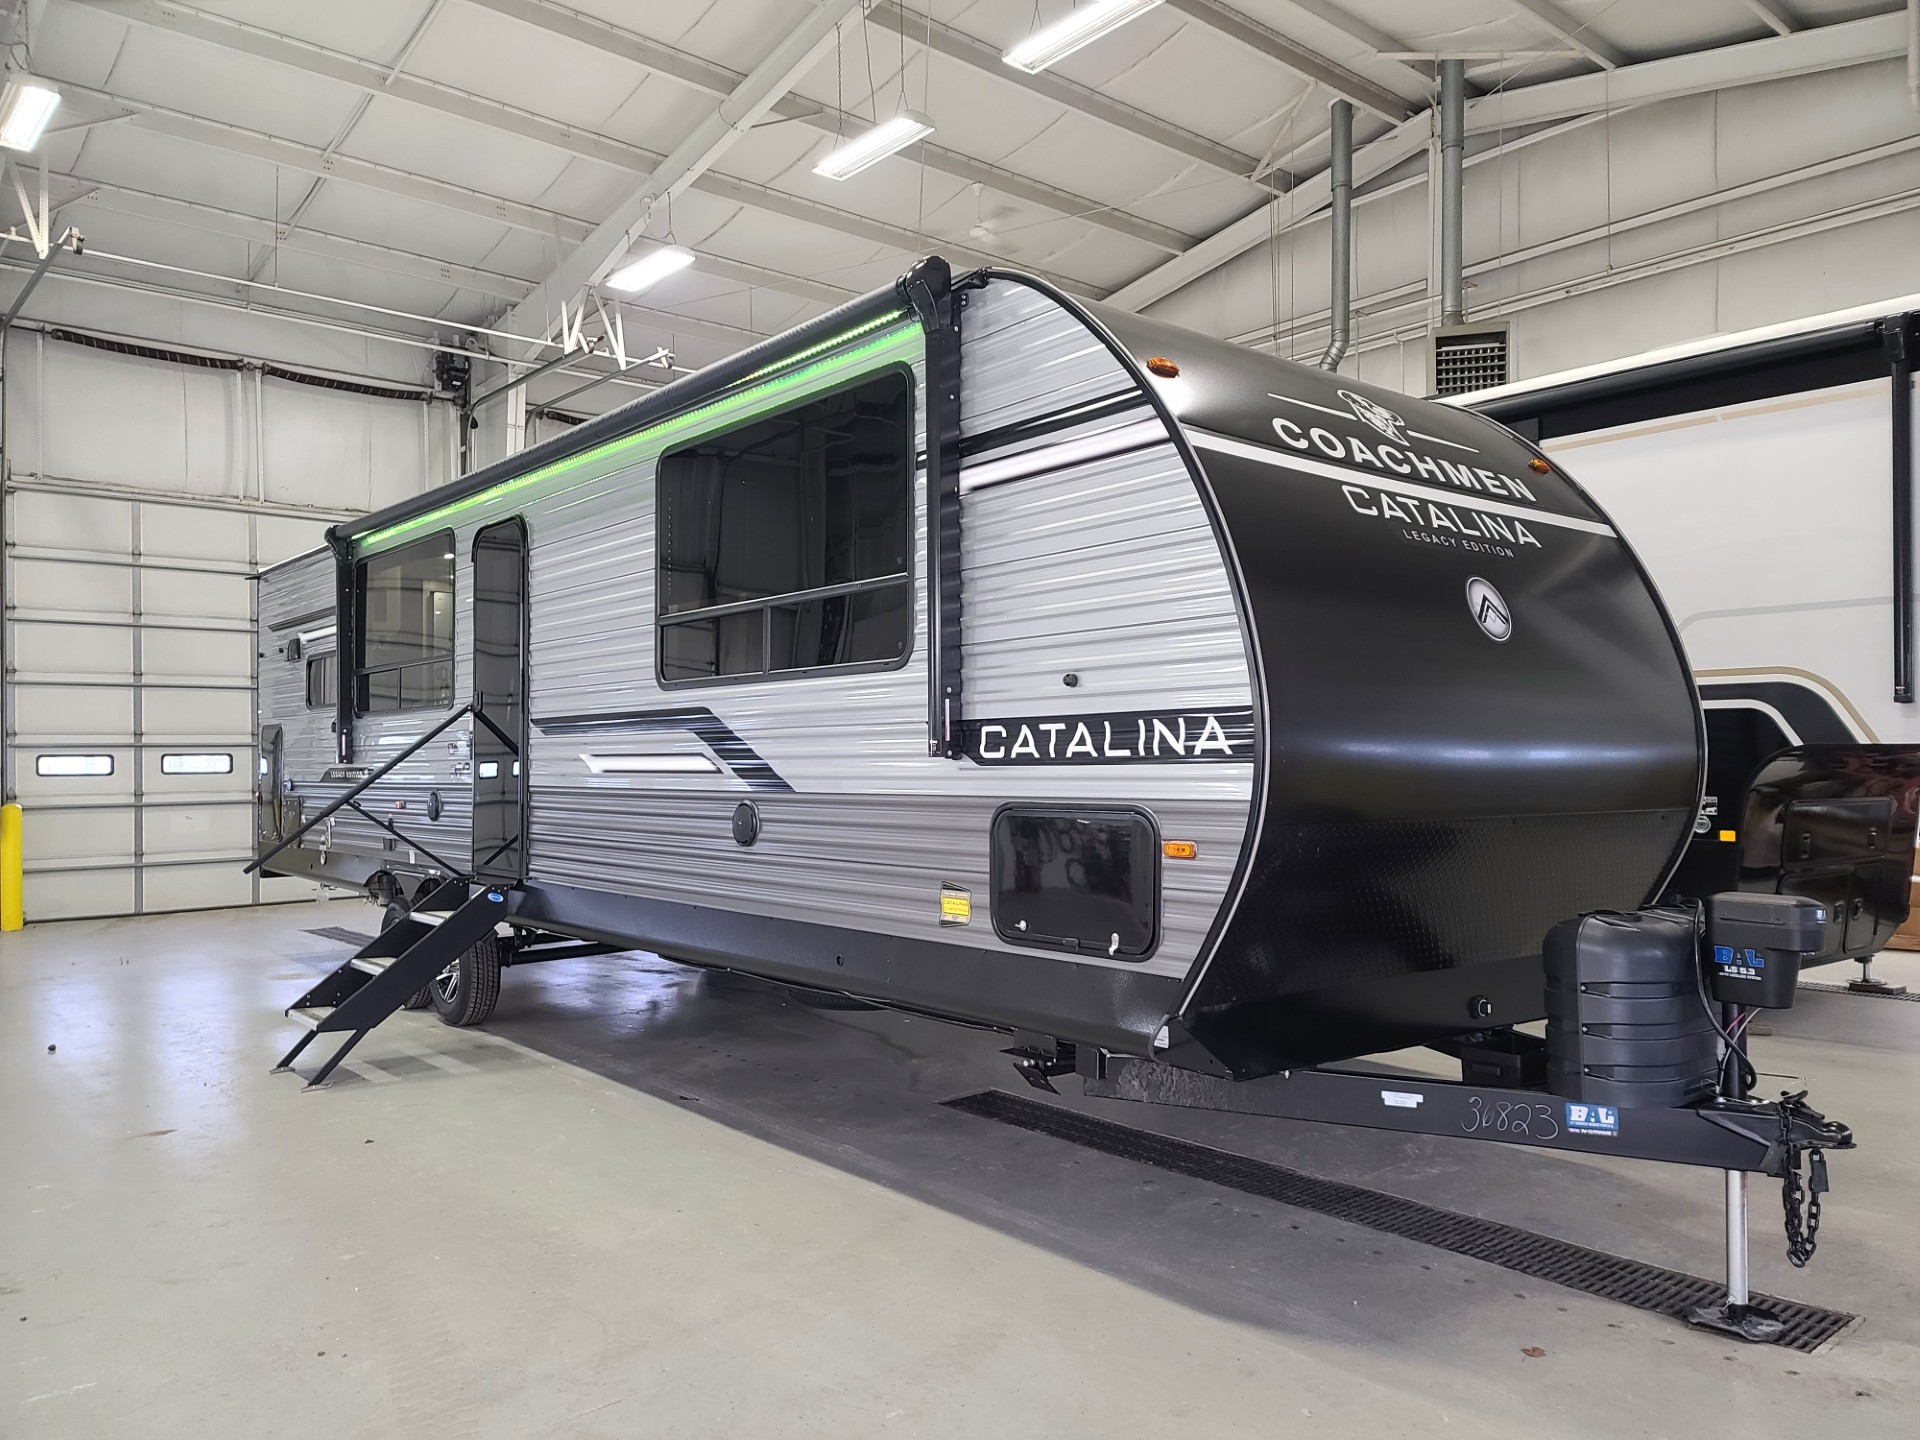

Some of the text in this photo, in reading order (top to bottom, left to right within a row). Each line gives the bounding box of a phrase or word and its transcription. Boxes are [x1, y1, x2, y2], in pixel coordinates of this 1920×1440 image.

[1271, 416, 1538, 502] COACHMEN
[1341, 483, 1543, 549] CATALINA
[1402, 528, 1515, 559] LEGACY EDITION
[979, 715, 1234, 759] CATALINA
[1714, 945, 1765, 968] BAL
[1461, 1096, 1559, 1140] 36823
[1569, 1105, 1615, 1124] BAL
